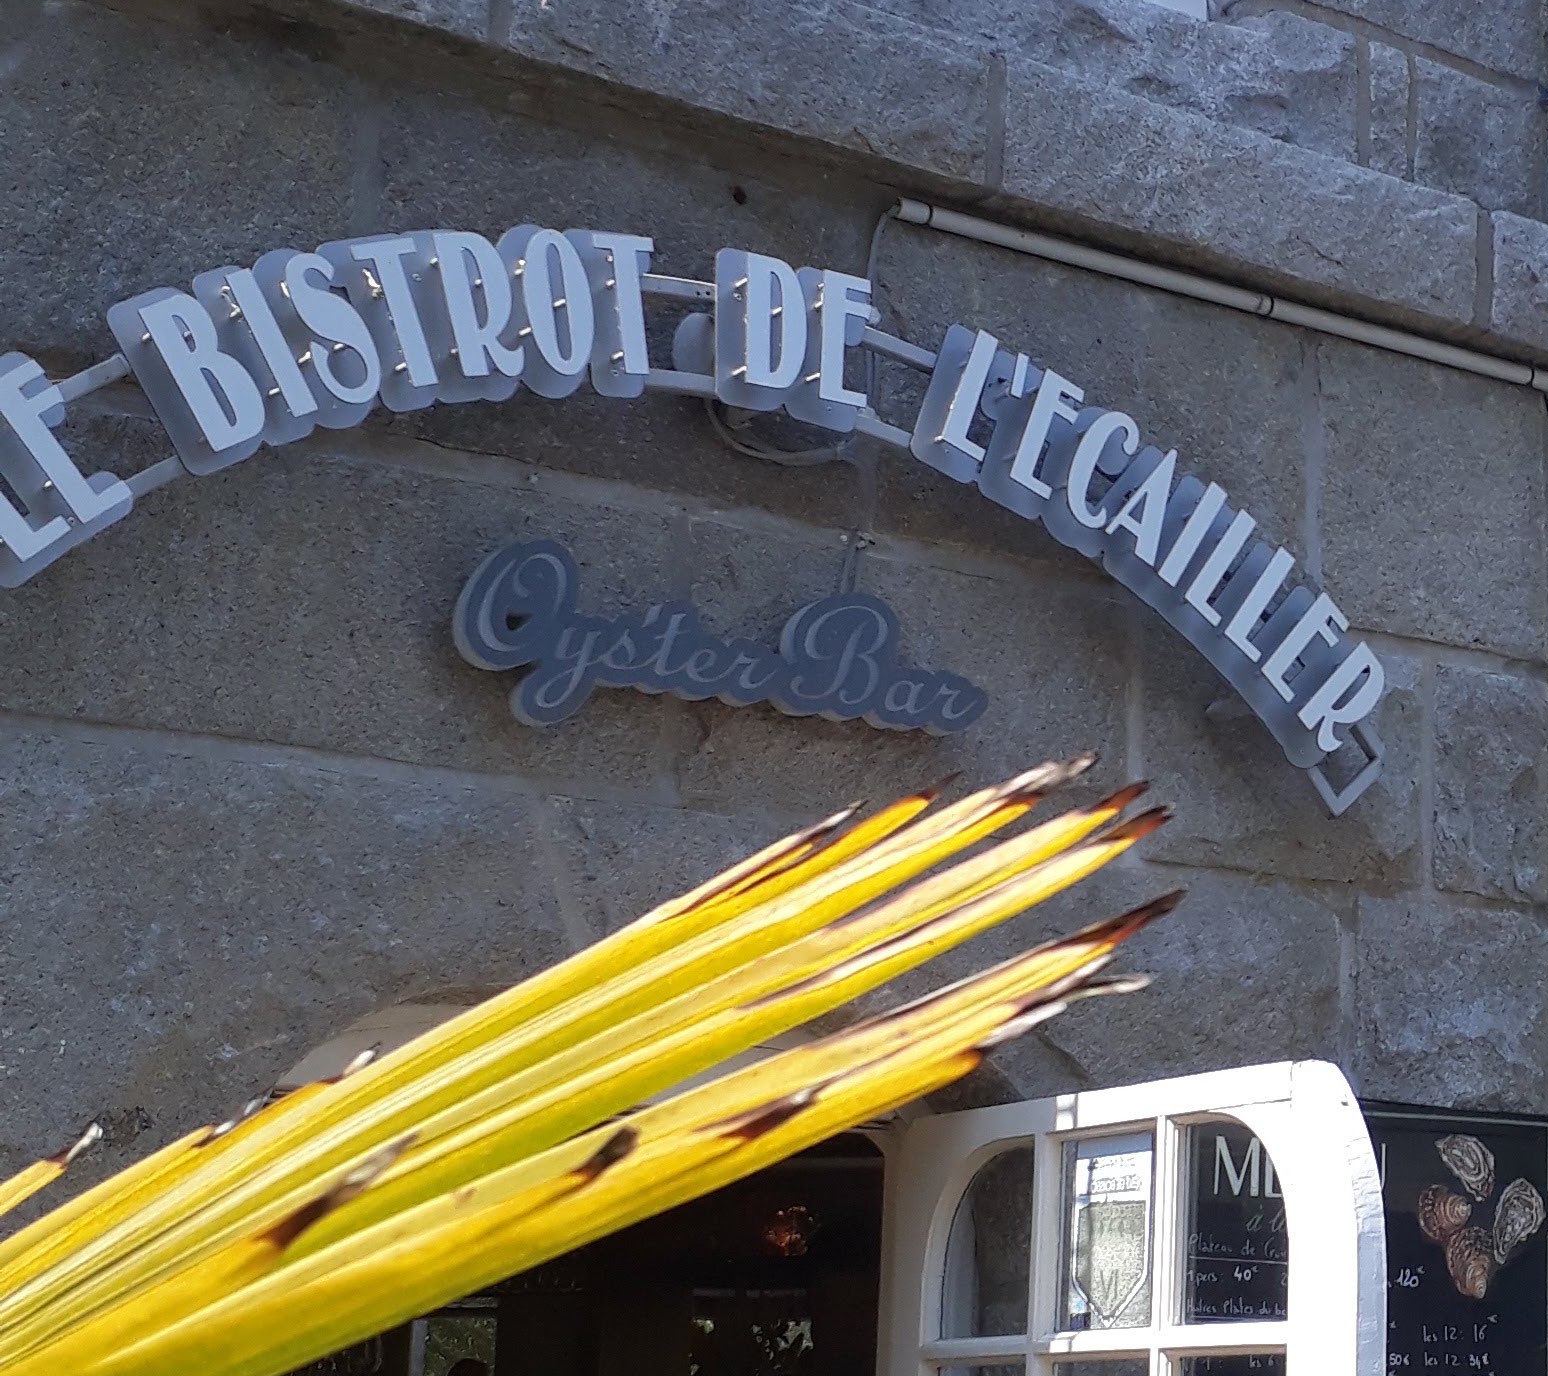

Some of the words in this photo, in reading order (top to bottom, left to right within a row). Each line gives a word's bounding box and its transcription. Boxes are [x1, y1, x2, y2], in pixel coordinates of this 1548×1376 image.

[138, 228, 655, 452] BISTROT
[744, 252, 873, 408] DE
[940, 328, 1385, 752] L'ECAILLER
[477, 552, 779, 709] Oyster
[788, 604, 978, 721] Bar
